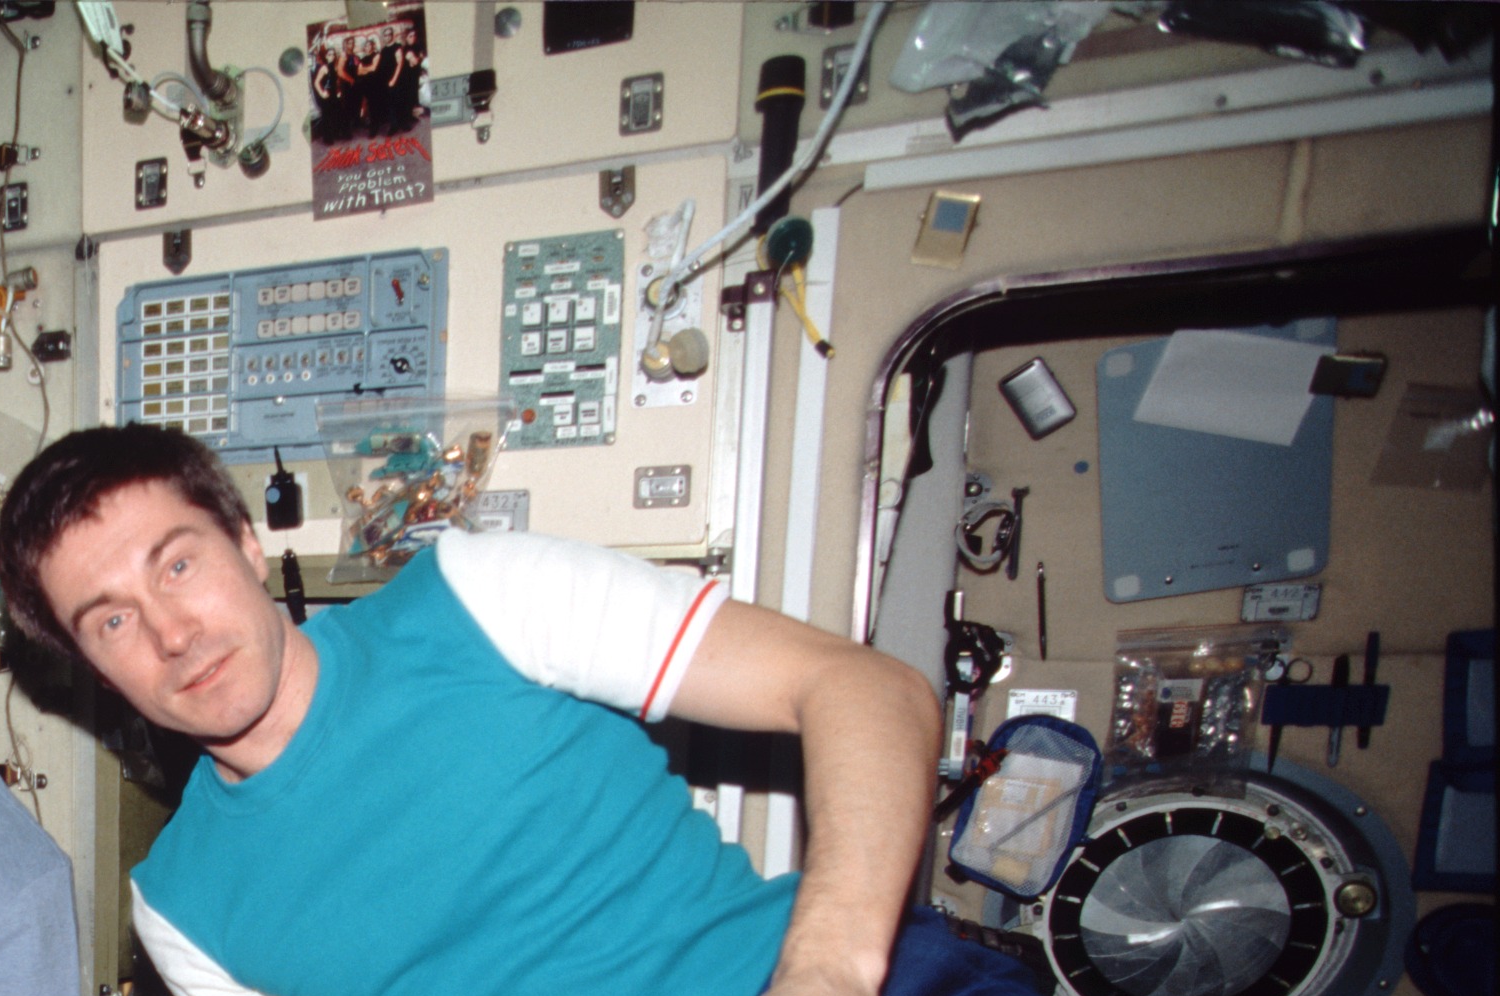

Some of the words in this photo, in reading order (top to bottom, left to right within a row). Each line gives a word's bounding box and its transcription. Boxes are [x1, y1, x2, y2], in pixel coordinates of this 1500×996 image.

[312, 143, 364, 173] Think
[366, 137, 431, 163] Safety
[366, 166, 391, 178] Got
[323, 194, 367, 213] with
[370, 182, 426, 205] That?
[1032, 694, 1058, 706] 443
